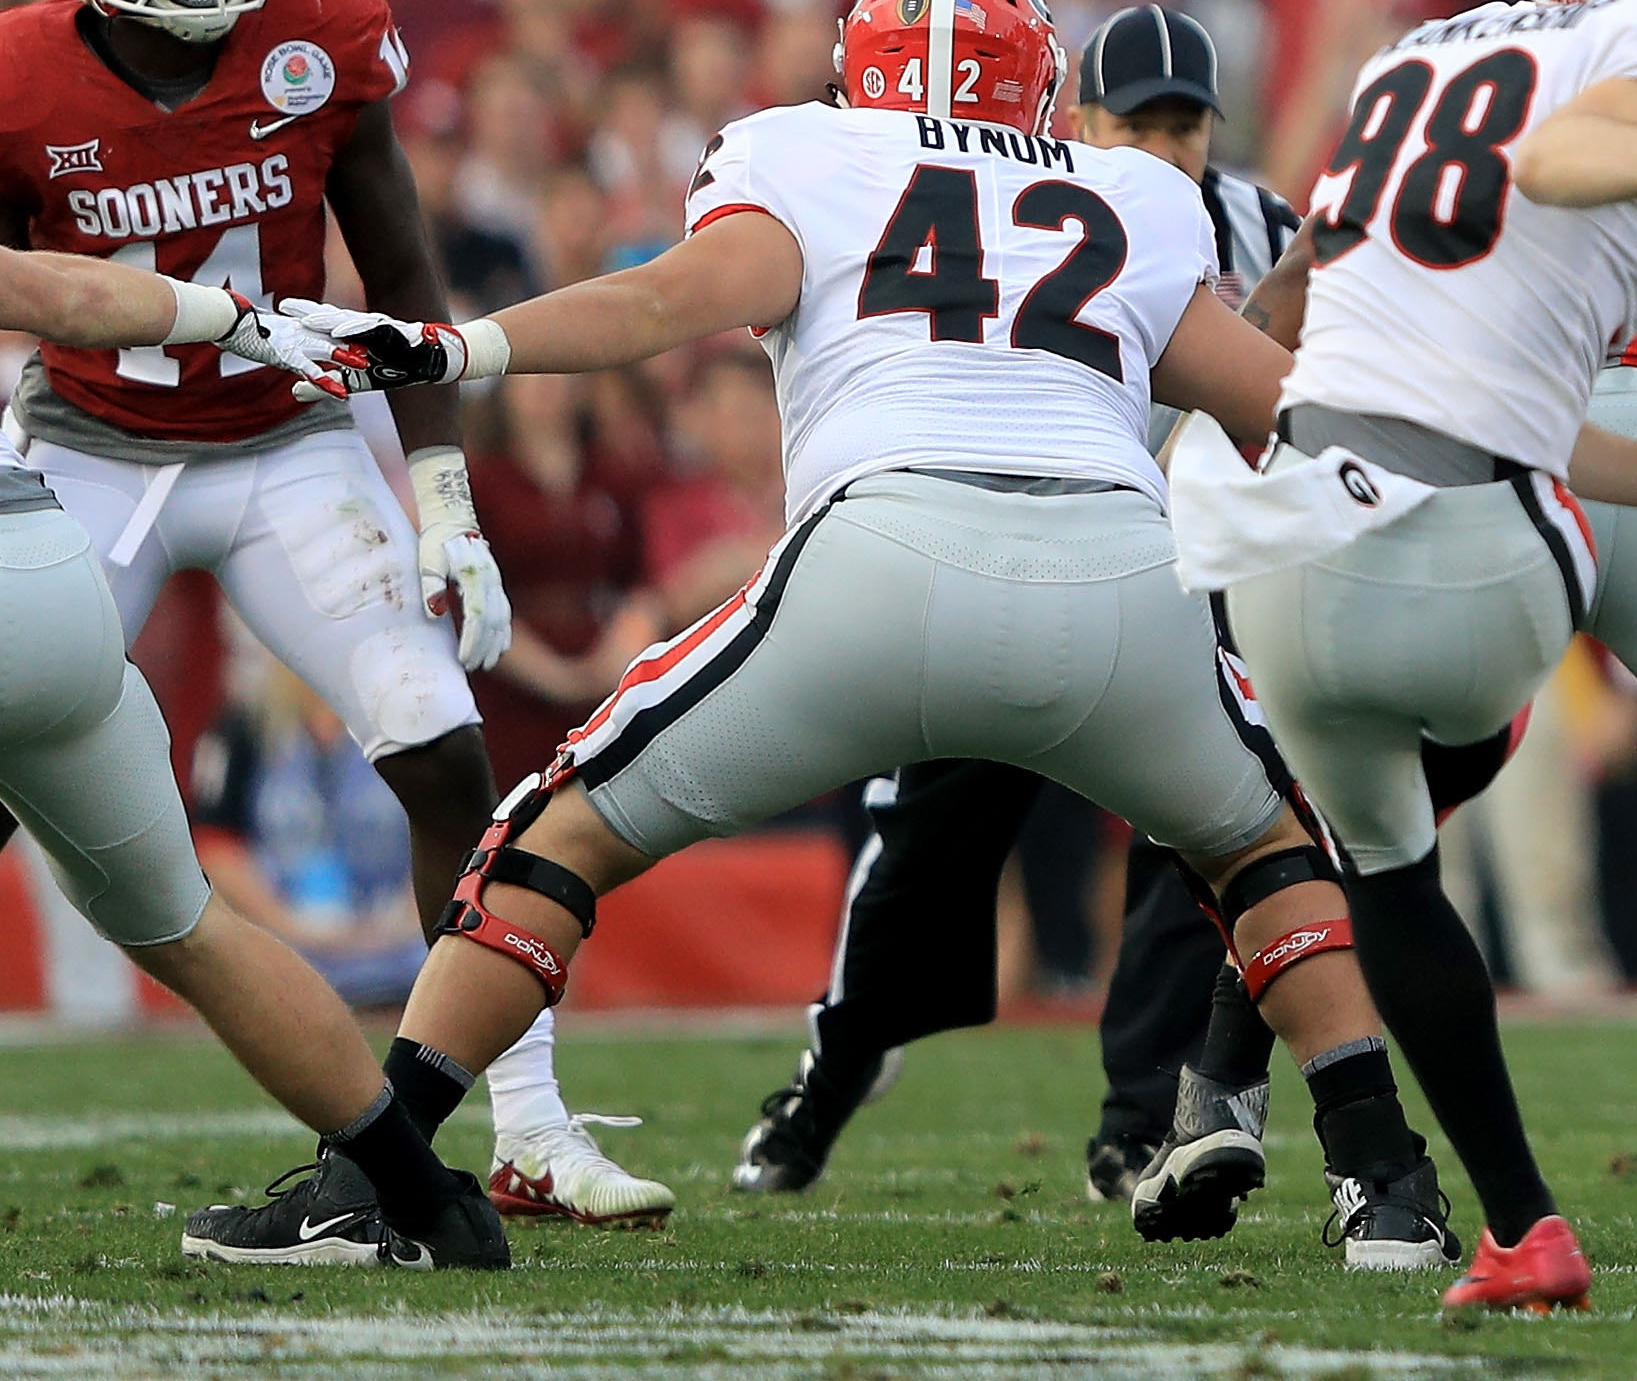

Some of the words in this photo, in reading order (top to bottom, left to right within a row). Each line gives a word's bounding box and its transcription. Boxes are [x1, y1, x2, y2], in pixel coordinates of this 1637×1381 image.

[914, 114, 1076, 174] BYNUM
[1311, 45, 1540, 273] 98
[67, 153, 294, 239] SOONERS
[856, 163, 1129, 385] 42
[503, 932, 561, 976] DONJOY
[1262, 928, 1329, 966] DONJOY
